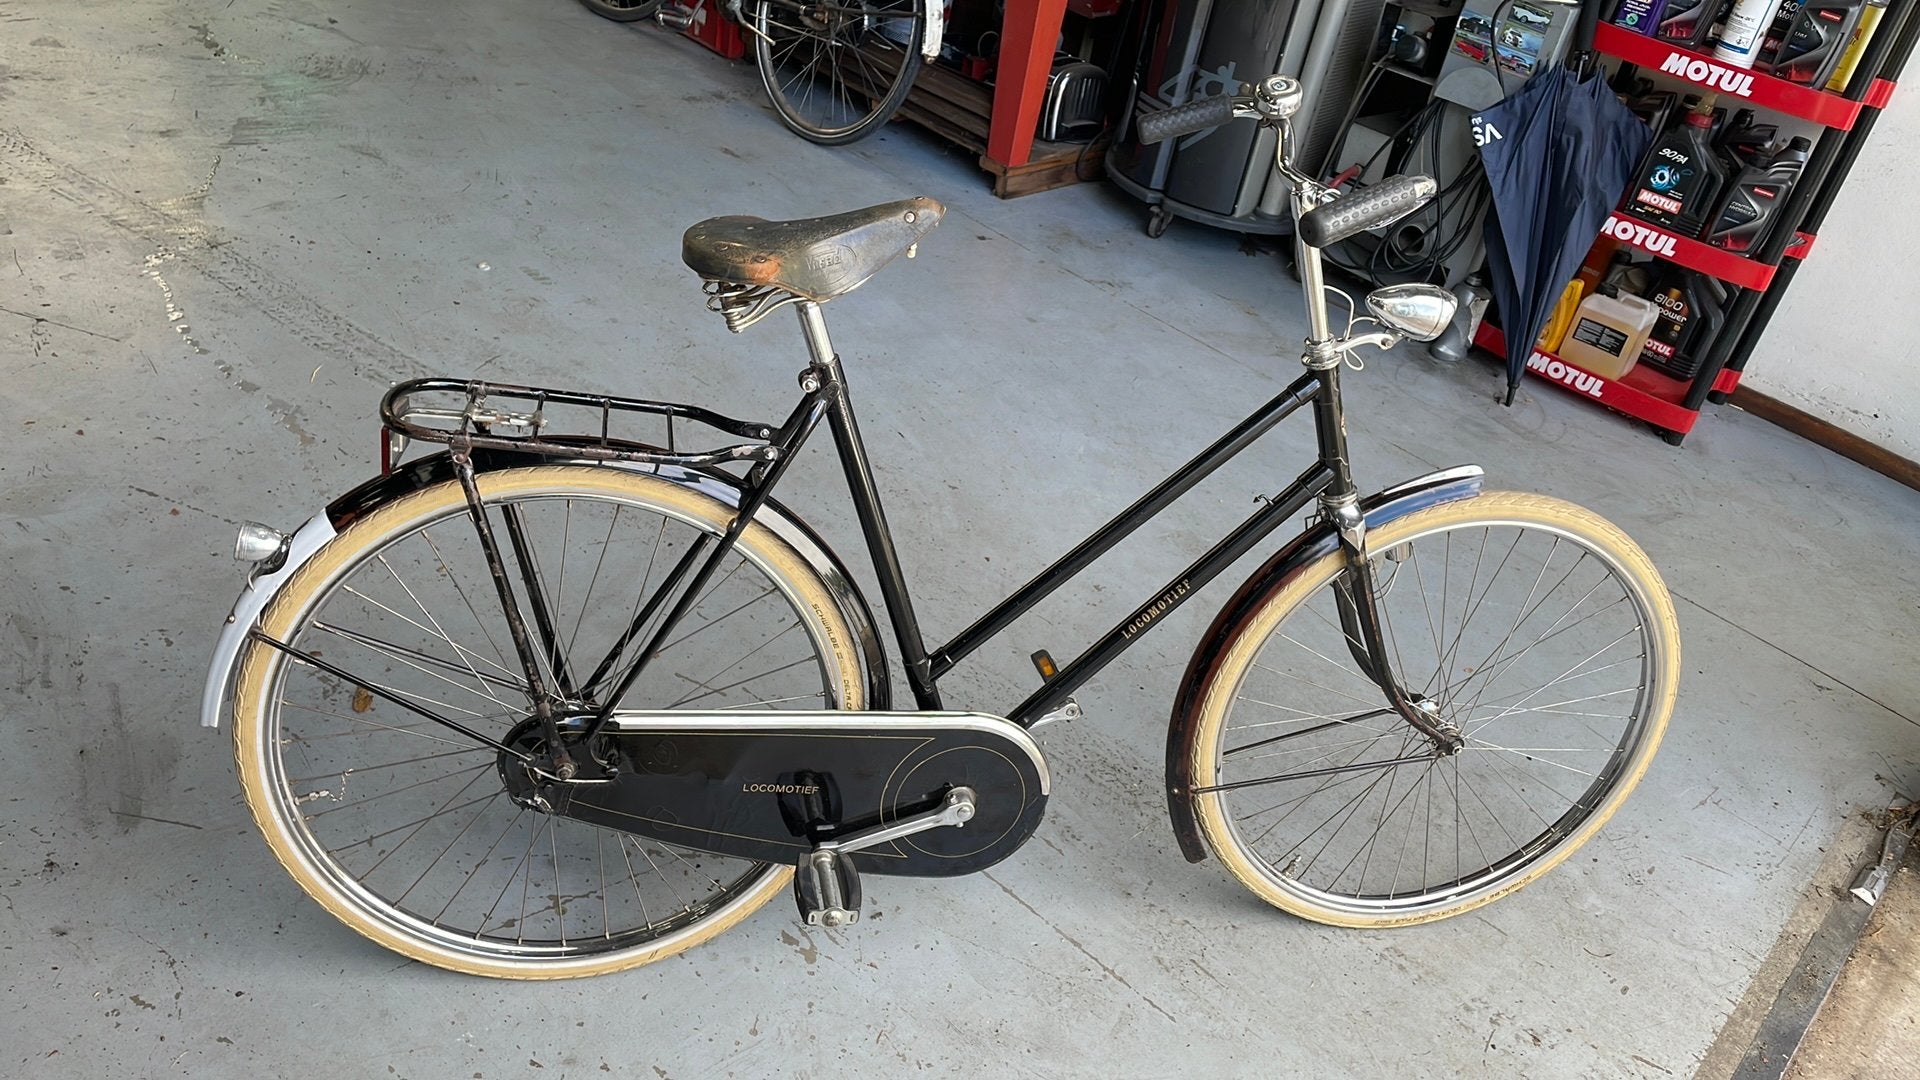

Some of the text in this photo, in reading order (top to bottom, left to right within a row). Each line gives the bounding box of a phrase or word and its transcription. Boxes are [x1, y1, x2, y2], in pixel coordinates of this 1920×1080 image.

[1659, 51, 1755, 97] MOTUL
[1640, 191, 1679, 212] MOTUL
[1654, 293, 1684, 311] 8100
[1645, 338, 1672, 356] OTUL
[1527, 351, 1605, 398] MOTUL
[1121, 578, 1191, 640] LOCOMOTIEF
[812, 603, 840, 650] SCHWALBE
[742, 783, 820, 795] LOCOMOTIEF
